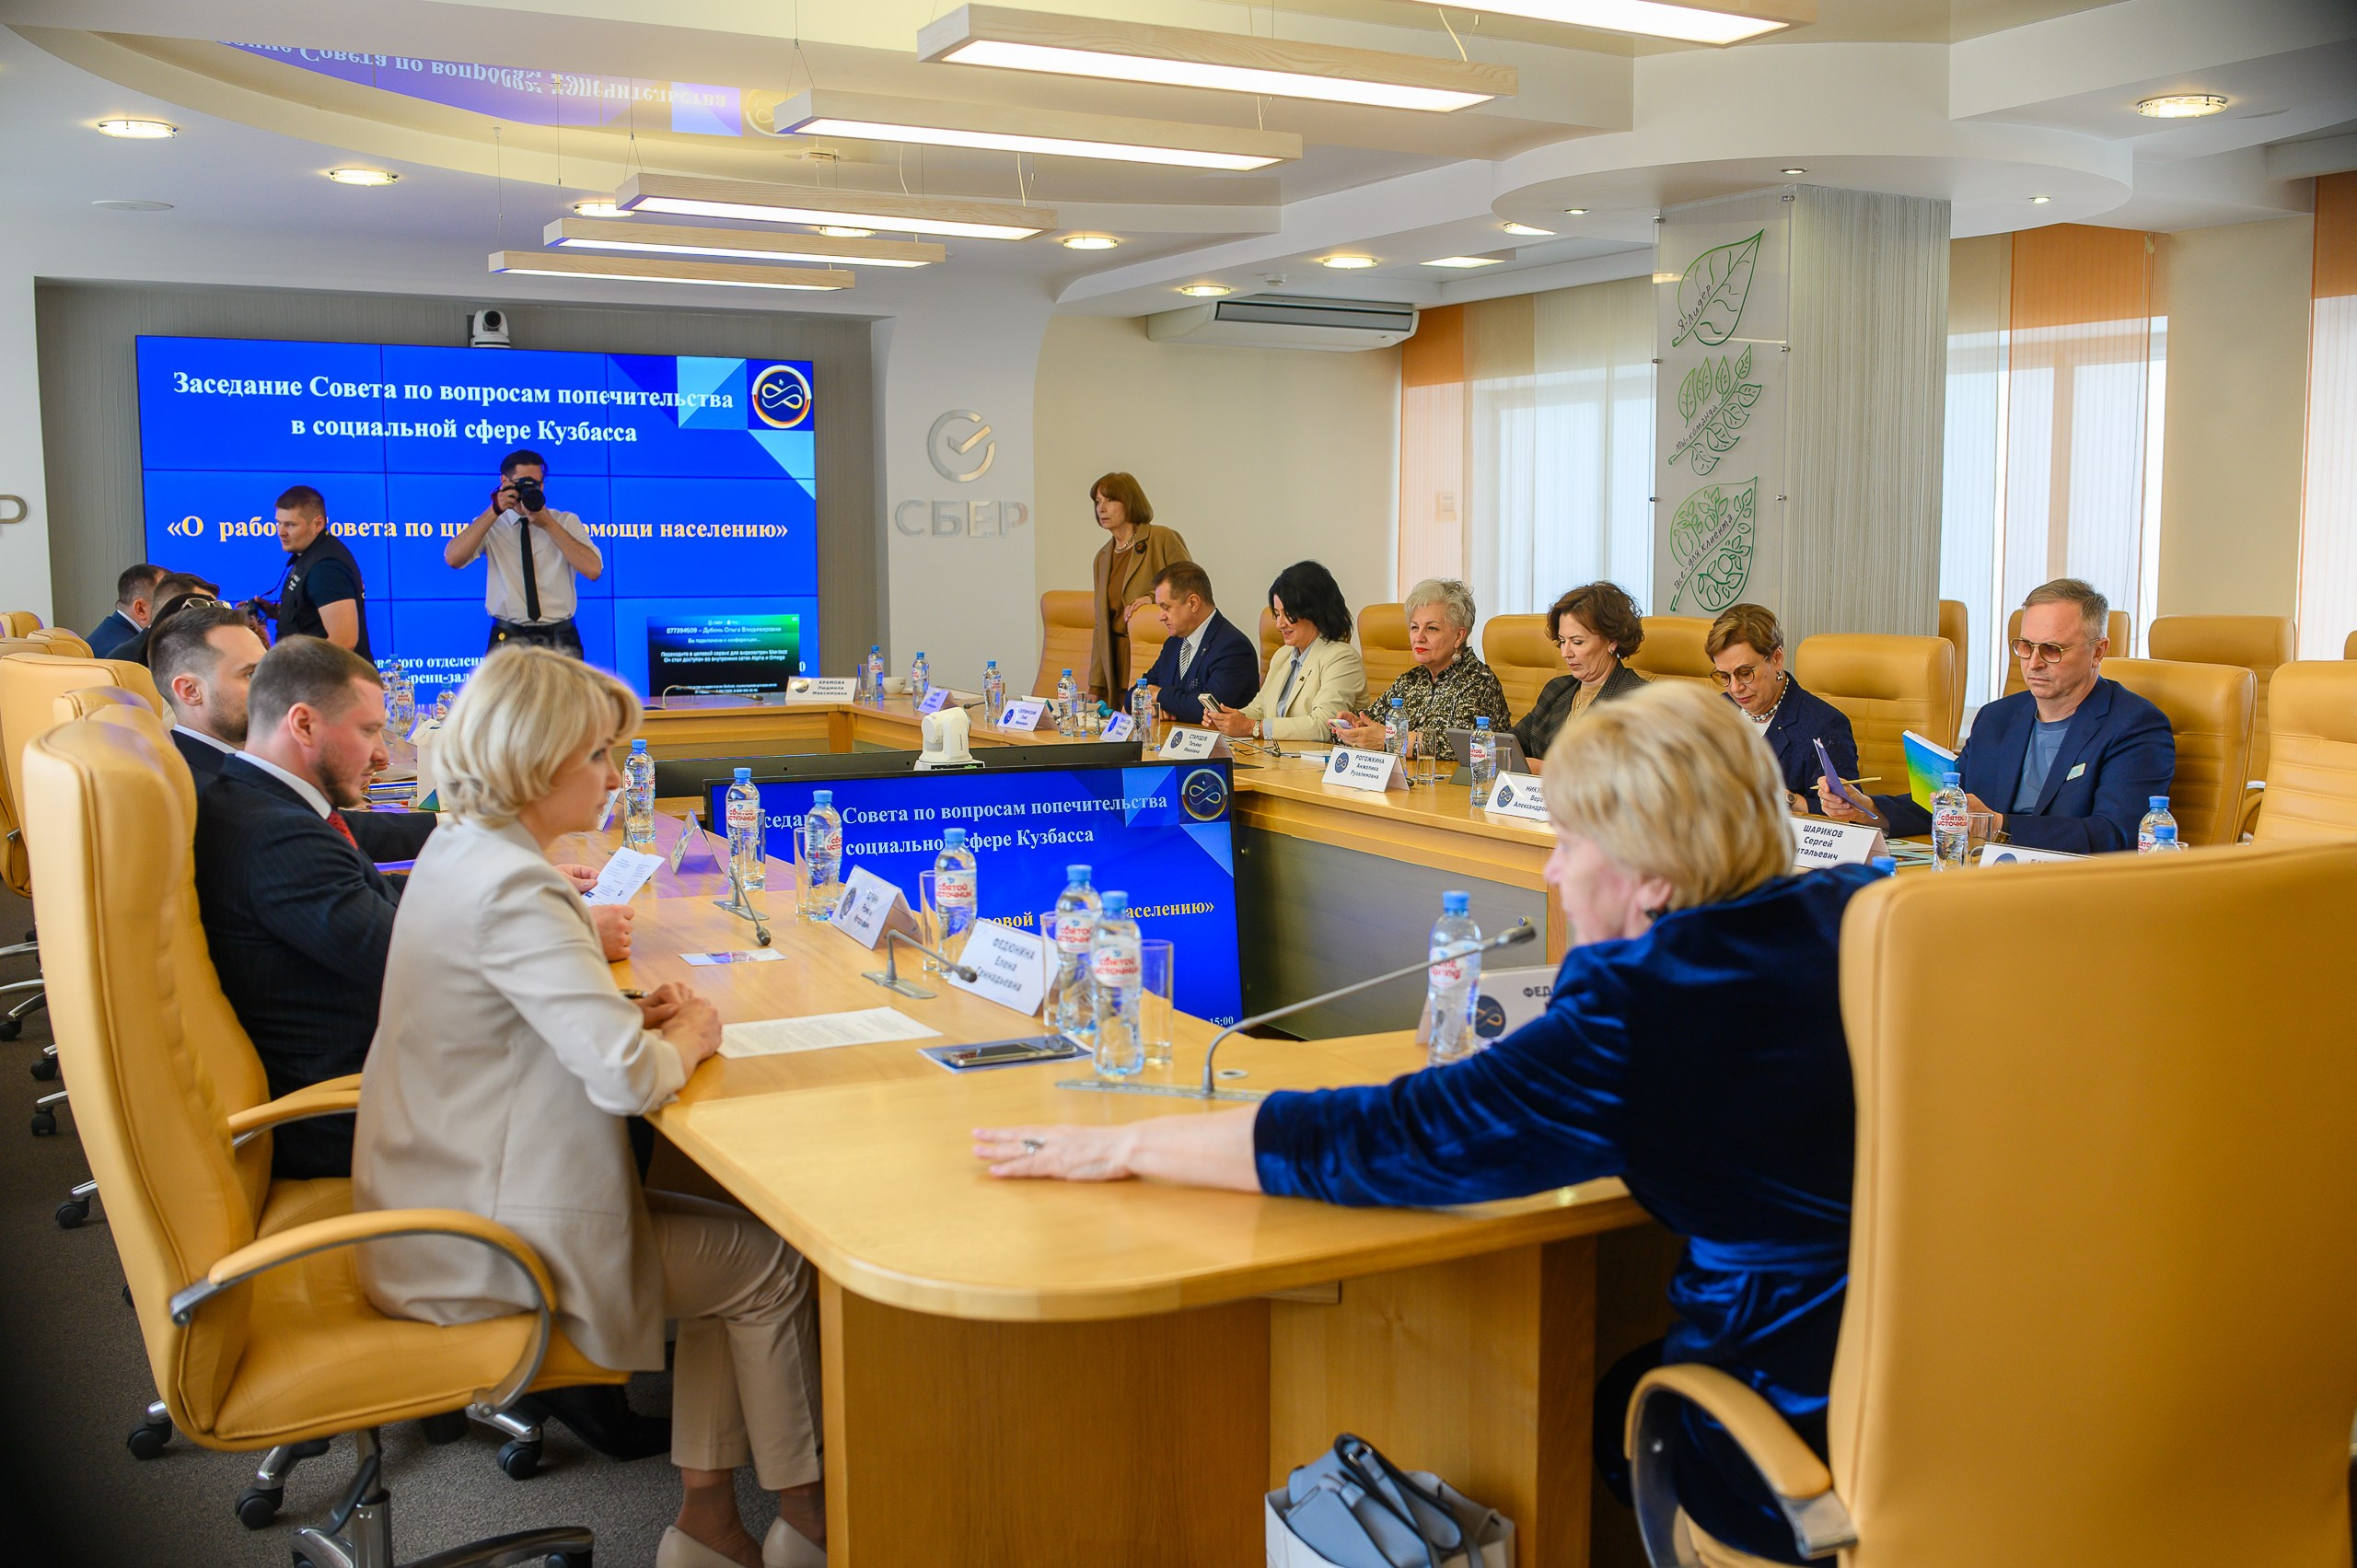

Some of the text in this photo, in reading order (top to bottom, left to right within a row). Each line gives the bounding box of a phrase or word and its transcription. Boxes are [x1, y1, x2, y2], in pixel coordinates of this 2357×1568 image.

[173, 371, 733, 409] Заседание Совета по вопросам попечительства
[291, 418, 637, 445] в социальной сфере Кузбасса
[895, 499, 1028, 538] СБЕР
[167, 516, 204, 537] «О
[219, 517, 277, 542] рабо
[327, 520, 398, 538] овета
[405, 521, 433, 537] по
[582, 522, 788, 540] омощи населению»
[426, 656, 485, 669] отделен
[1355, 755, 1385, 764] РОГОЖКИНА
[1357, 763, 1378, 772] Анжелика
[842, 796, 1167, 824] Совета по вопросам попечительства
[1514, 801, 1548, 812] Александро
[1804, 825, 1843, 838] ШАРИКОВ
[846, 837, 946, 856] социально
[1016, 827, 1094, 849] Кузбасса
[1805, 836, 1833, 847] Сергей
[1795, 847, 1839, 860] итальевич
[1125, 900, 1214, 919] аселению»
[1523, 986, 1552, 997] ФЕД
